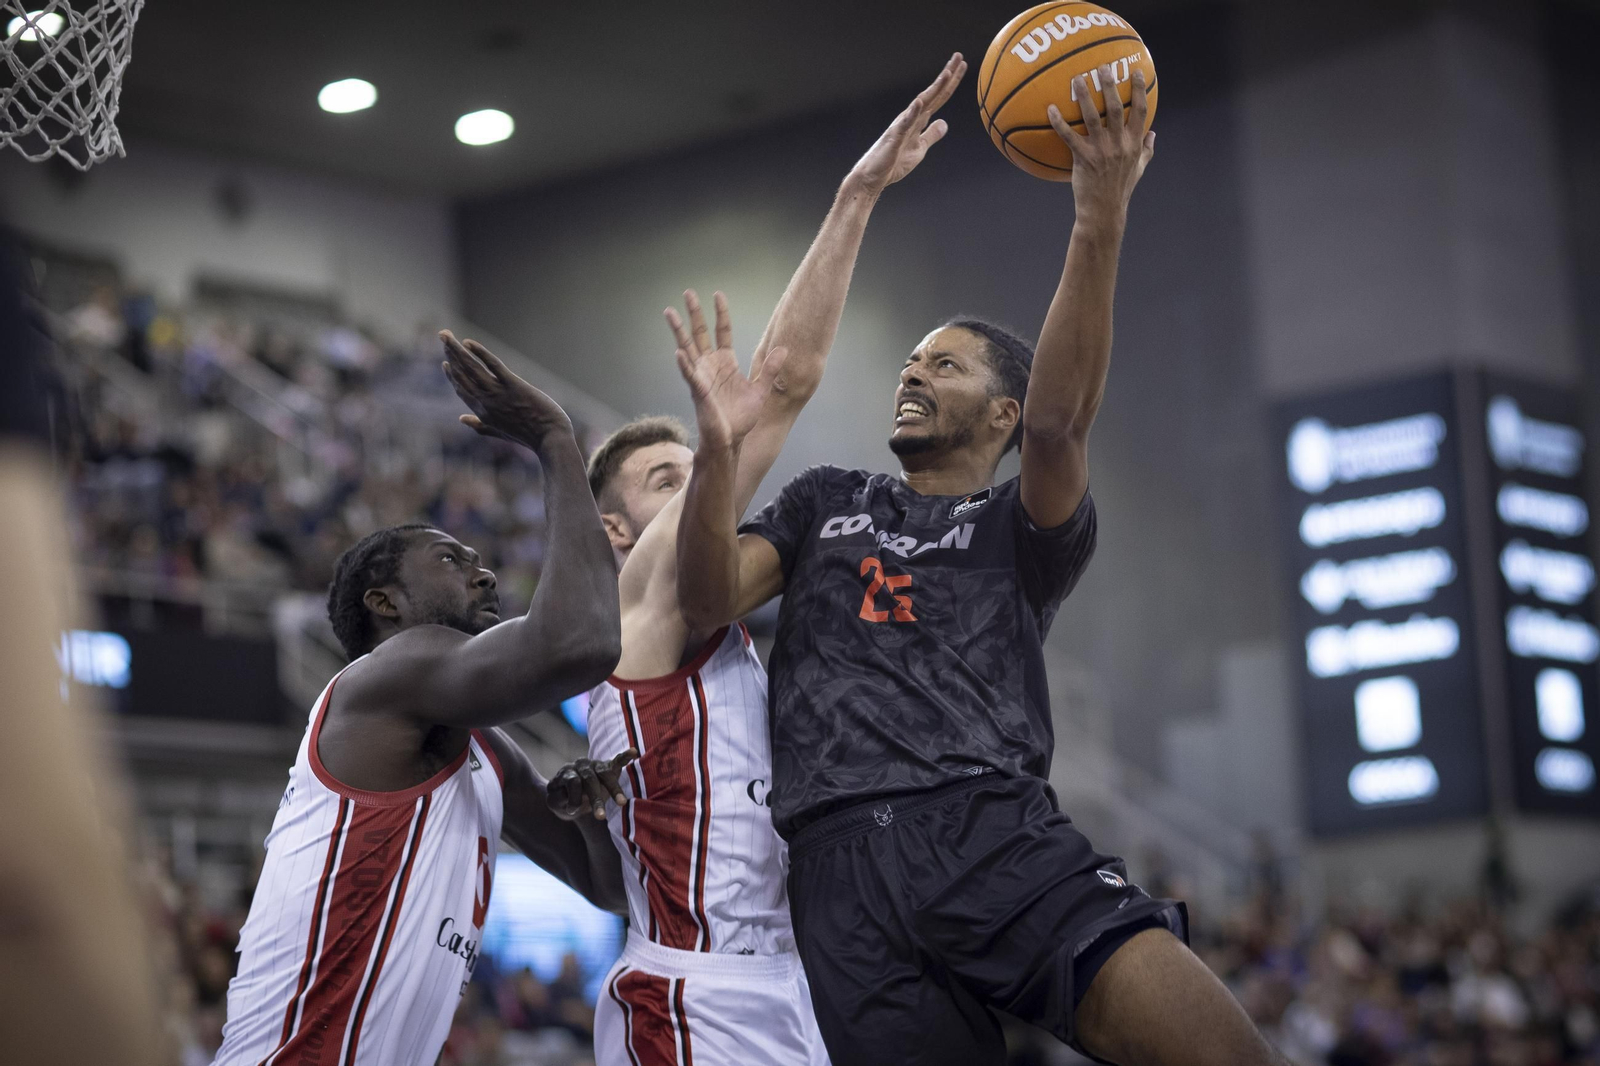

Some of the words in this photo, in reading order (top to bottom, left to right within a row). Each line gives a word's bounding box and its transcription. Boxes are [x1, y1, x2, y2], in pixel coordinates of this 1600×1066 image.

[1011, 13, 1126, 63] Wilson
[1128, 52, 1142, 64] NXT
[859, 557, 919, 622] 25
